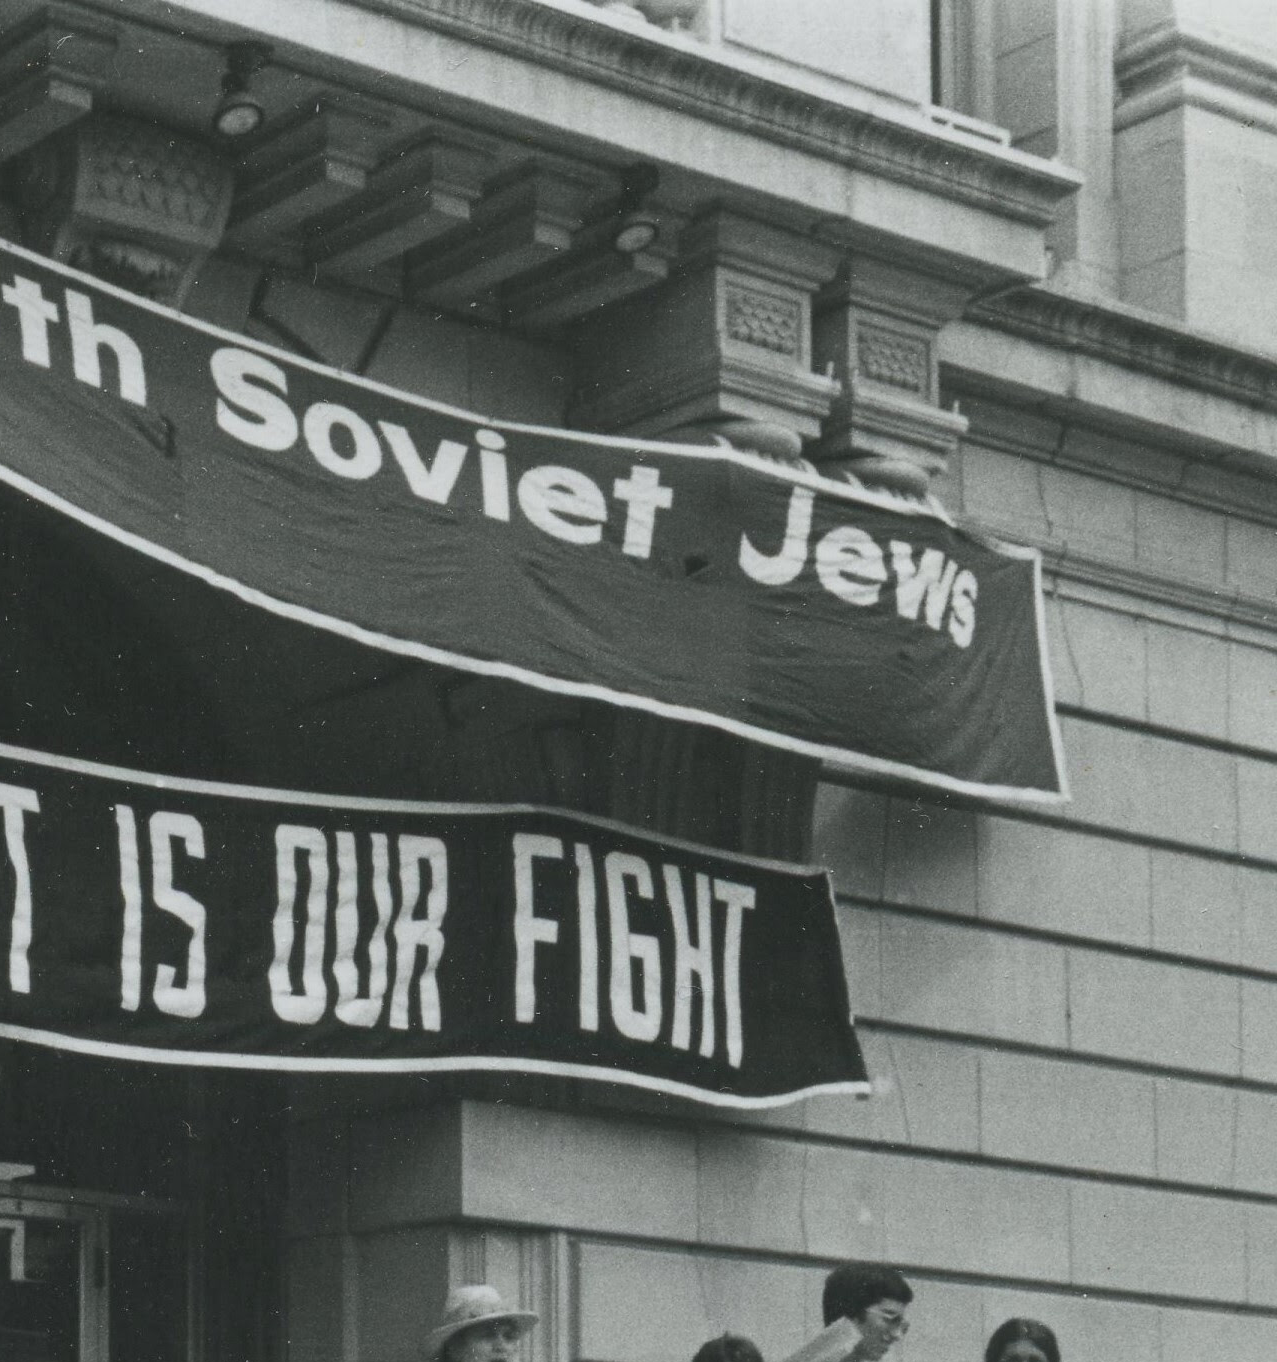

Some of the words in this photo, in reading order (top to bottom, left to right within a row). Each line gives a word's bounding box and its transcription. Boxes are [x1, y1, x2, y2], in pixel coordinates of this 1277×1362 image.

[211, 347, 673, 559] Soviet
[740, 488, 980, 649] Jews
[116, 804, 207, 1018] IS
[268, 824, 448, 1031] OUR
[513, 833, 755, 1069] FIGHT
